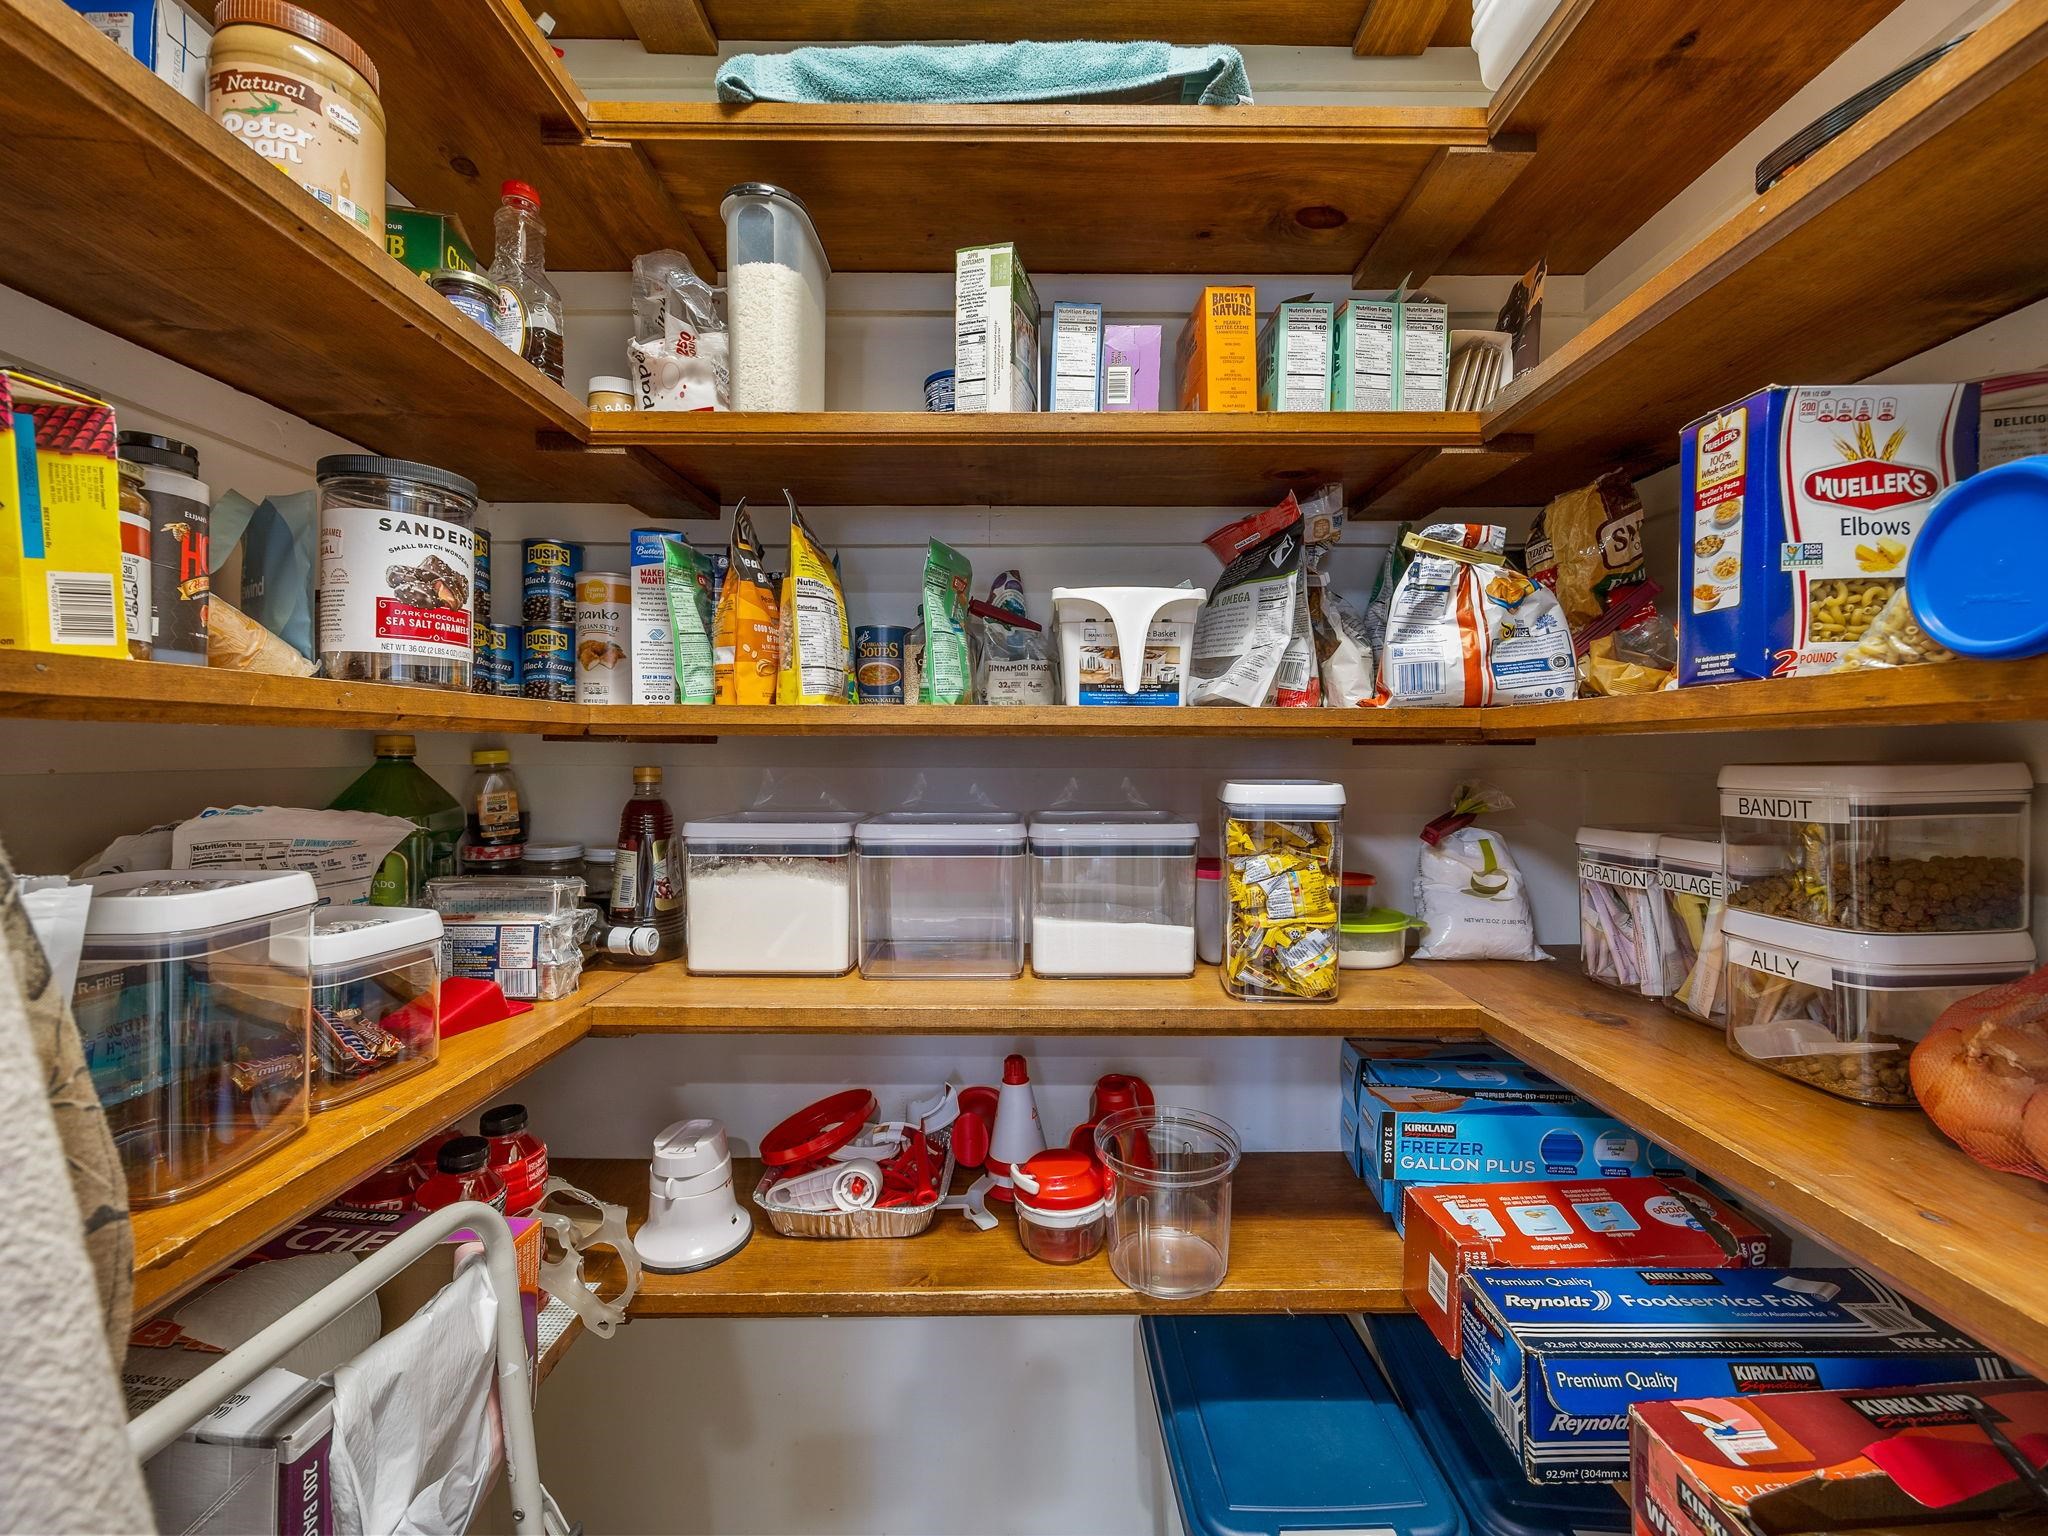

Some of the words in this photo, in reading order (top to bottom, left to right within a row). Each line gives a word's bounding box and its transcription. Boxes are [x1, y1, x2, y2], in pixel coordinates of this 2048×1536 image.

[225, 74, 306, 101] Natural
[221, 113, 315, 148] Peter
[247, 139, 304, 164] an
[1212, 292, 1238, 307] BACK
[1239, 293, 1252, 305] TO
[1212, 303, 1252, 317] NATURE
[676, 331, 692, 357] 250
[1801, 402, 1816, 412] 200
[1704, 429, 1740, 452] MUELLER'S
[1709, 451, 1732, 466] 100%
[1719, 460, 1738, 471] Grain
[1699, 484, 1723, 500] Mueller's
[1723, 480, 1740, 491] Pasta
[1813, 469, 1931, 501] MUELLER'S
[1706, 495, 1723, 505] Great
[378, 516, 473, 551] SANDERS
[1840, 517, 1911, 537] Elbows
[388, 542, 416, 554] SMALL
[417, 542, 444, 551] BATCH
[444, 548, 470, 569] WONDERS
[528, 547, 569, 565] BUSH'S
[524, 575, 546, 585] Black
[547, 576, 575, 589] Beans
[640, 576, 665, 585] WANT
[796, 577, 825, 590] Nutrition
[1221, 591, 1251, 606] OMEGA
[796, 603, 818, 611] Calories
[394, 609, 420, 617] DARK
[423, 612, 466, 625] CHOCOLATE
[579, 608, 620, 623] panko
[385, 616, 405, 626] SEA
[408, 618, 433, 629] SALT
[434, 622, 470, 636] CARAMELS
[1152, 630, 1177, 638] Basket
[381, 643, 394, 651] NET
[526, 633, 567, 649] BUSH'S
[859, 642, 899, 658] SOUPS
[1719, 653, 1736, 661] recipes
[523, 660, 544, 672] Black
[545, 661, 573, 672] Beans
[1772, 649, 1800, 676] 2
[1800, 652, 1838, 665] POUNDS
[1738, 797, 1813, 820] BANDIT
[192, 842, 228, 851] Nutrition
[1578, 862, 1647, 888] YDRATION
[1750, 949, 1800, 979] ALLY
[357, 1029, 384, 1045] minis
[257, 1061, 293, 1077] minis
[1384, 1126, 1393, 1137] 32
[1404, 1123, 1455, 1134] KIRKLAND
[1384, 1140, 1393, 1164] BAGS
[1401, 1140, 1484, 1156] FREEZER
[1401, 1156, 1480, 1172] GALLON
[1486, 1159, 1536, 1174] PLUS
[321, 1209, 401, 1222] KIRKLAND
[1530, 1243, 1559, 1251] Solutions
[1750, 1241, 1767, 1266] 80
[1485, 1277, 1545, 1286] Premium
[1545, 1277, 1593, 1288] Quality
[1640, 1271, 1715, 1281] KIRKLAND
[1505, 1294, 1592, 1310] Reynolds
[1618, 1295, 1761, 1309] Foodservice
[1763, 1294, 1811, 1308] Foil
[1769, 1310, 1808, 1318] Aluminum
[1809, 1310, 1827, 1318] Foil
[1670, 1341, 1694, 1349] 1000
[1893, 1337, 1974, 1350] RK611
[1556, 1371, 1623, 1388] Premium
[1625, 1372, 1678, 1392] Quality
[1733, 1366, 1816, 1381] KIRKLAND
[1740, 1380, 1821, 1392] Signature
[1852, 1394, 1985, 1416] KIRKLAND
[1549, 1413, 1630, 1436] Reynold
[1876, 1411, 1978, 1428] Signatur
[302, 1460, 318, 1502] 200
[1580, 1469, 1621, 1480] (304mm
